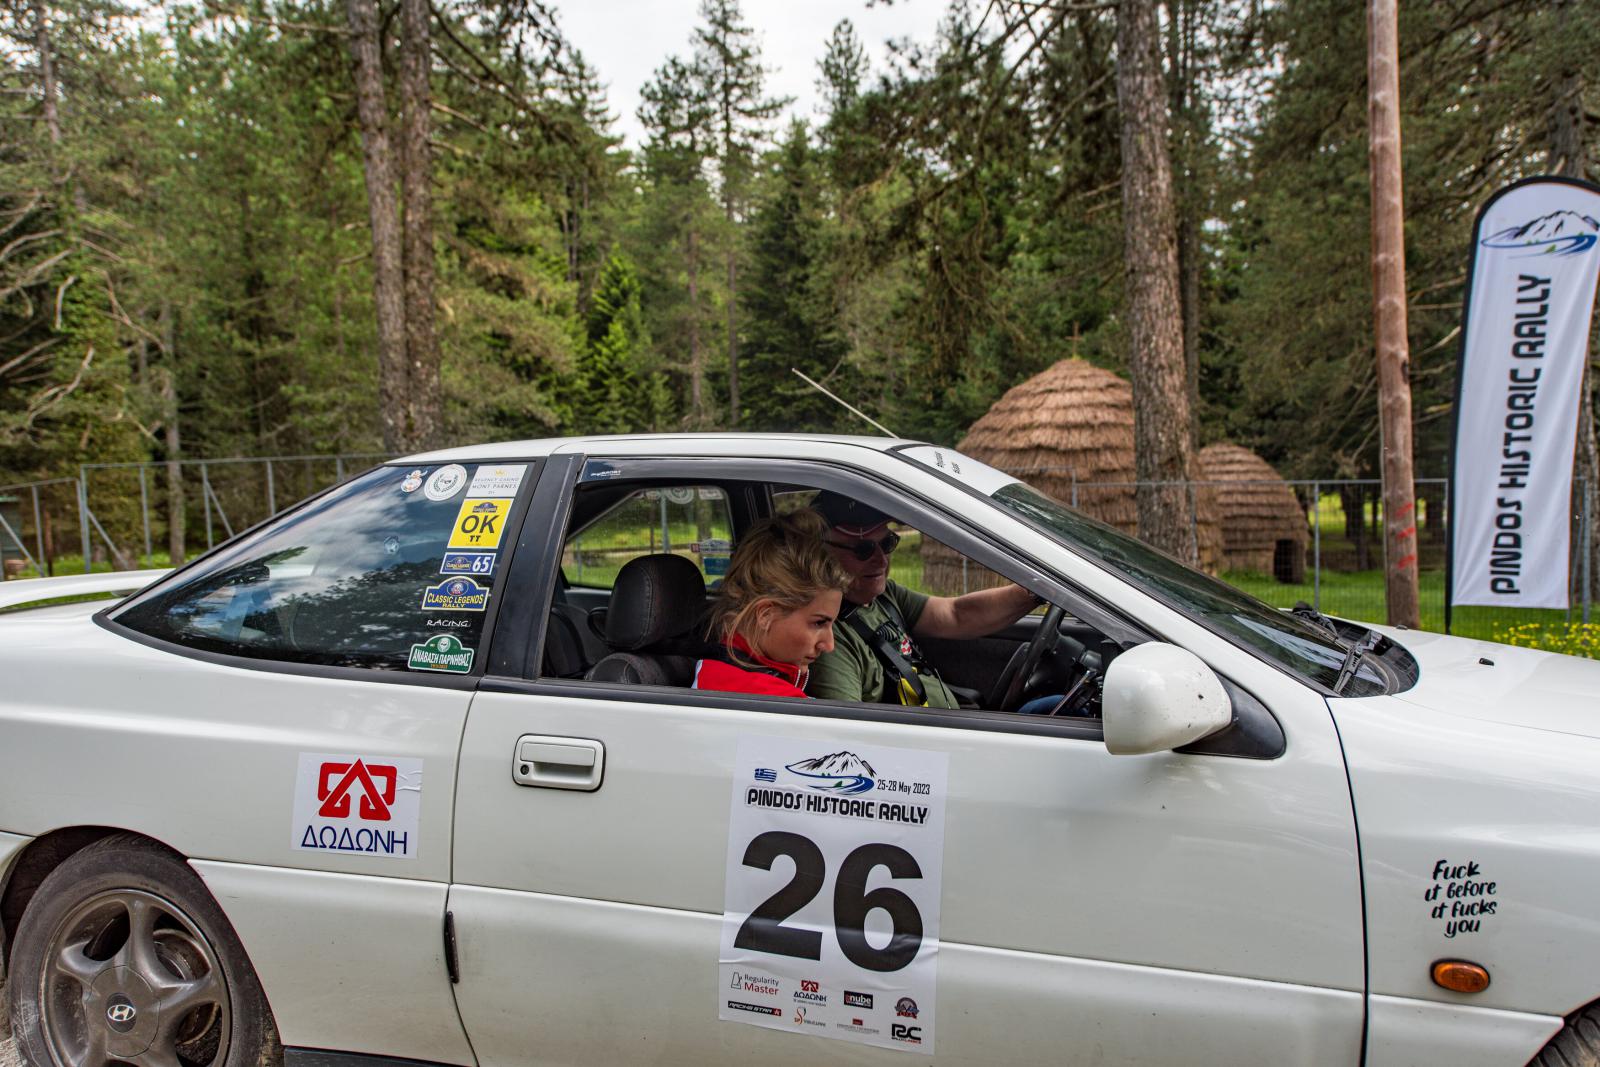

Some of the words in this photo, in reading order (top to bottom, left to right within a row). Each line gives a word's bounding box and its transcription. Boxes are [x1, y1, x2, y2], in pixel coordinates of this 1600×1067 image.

[1511, 274, 1551, 359] RALLY
[1498, 368, 1541, 489] HISTORIC
[461, 515, 499, 533] OK
[1490, 497, 1523, 595] PINDOS
[472, 556, 491, 572] 65
[427, 593, 454, 603] CLASSIC
[454, 594, 484, 604] LEGENDS
[426, 619, 469, 627] RACING
[411, 648, 439, 663] ΑΝΑΒΑΣΗ
[439, 653, 471, 666] ΠΑΡΝΗΘΑΣ
[877, 779, 897, 791] 25-28
[898, 780, 911, 795] May
[913, 783, 930, 795] 2023
[747, 788, 803, 809] PINDOS
[806, 795, 875, 818] HISTORIC
[878, 804, 928, 824] RALLY
[301, 825, 407, 854] ΔΩΔΩΝΗ
[1433, 860, 1480, 880] Fuck
[1447, 880, 1496, 899] before
[733, 831, 924, 972] 26
[1452, 899, 1497, 918] fucks
[1444, 920, 1480, 938] you
[744, 974, 779, 987] Regularity
[744, 982, 779, 995] Master
[793, 991, 827, 1001] ΔΩΔΩΝΗ
